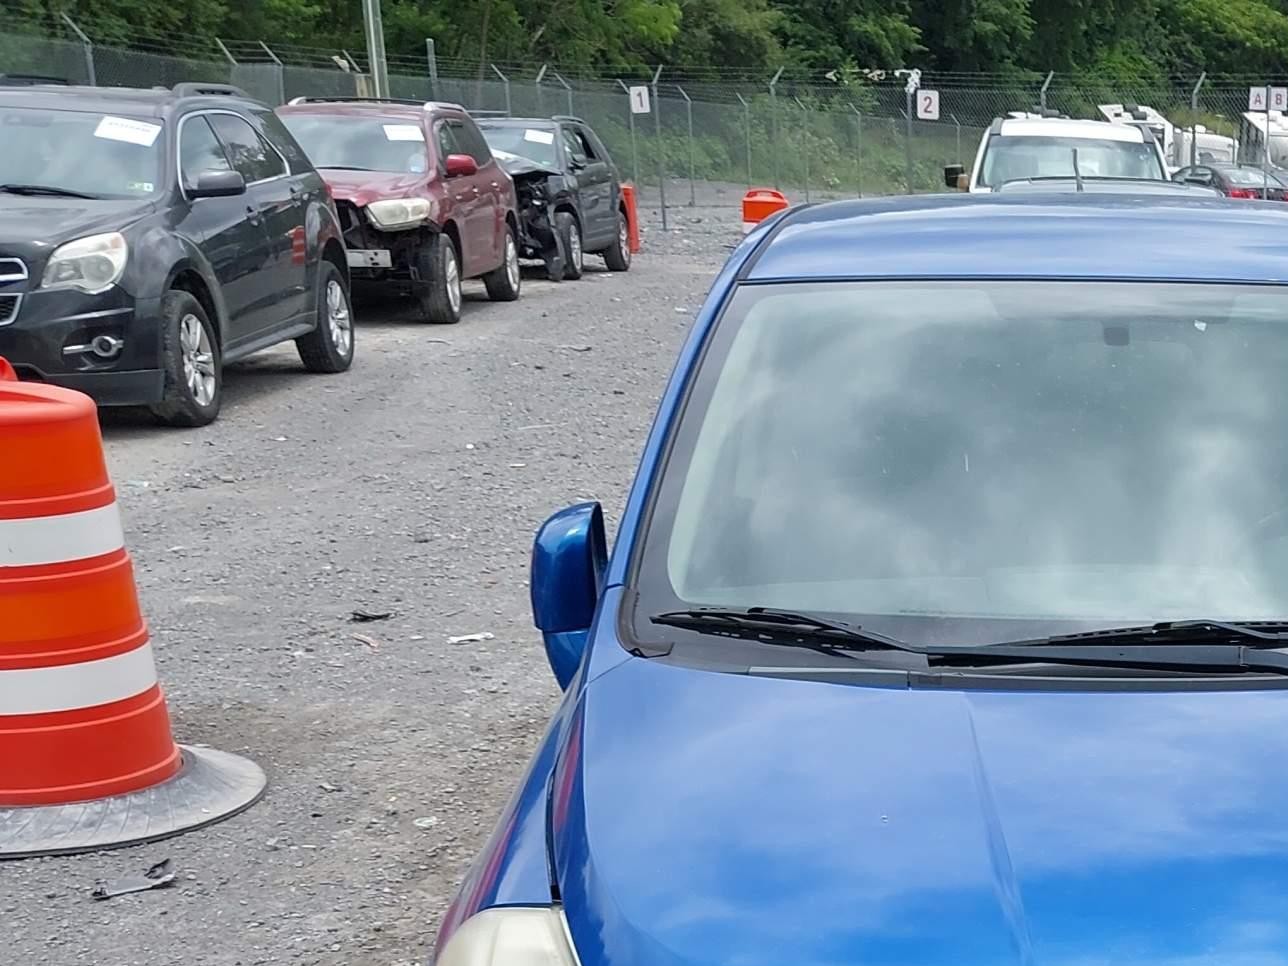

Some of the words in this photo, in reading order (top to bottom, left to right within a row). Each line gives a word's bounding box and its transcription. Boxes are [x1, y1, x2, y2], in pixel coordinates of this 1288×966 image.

[636, 91, 645, 109] 1
[923, 95, 933, 114] 2
[1254, 93, 1262, 105] A
[1275, 93, 1283, 106] B
